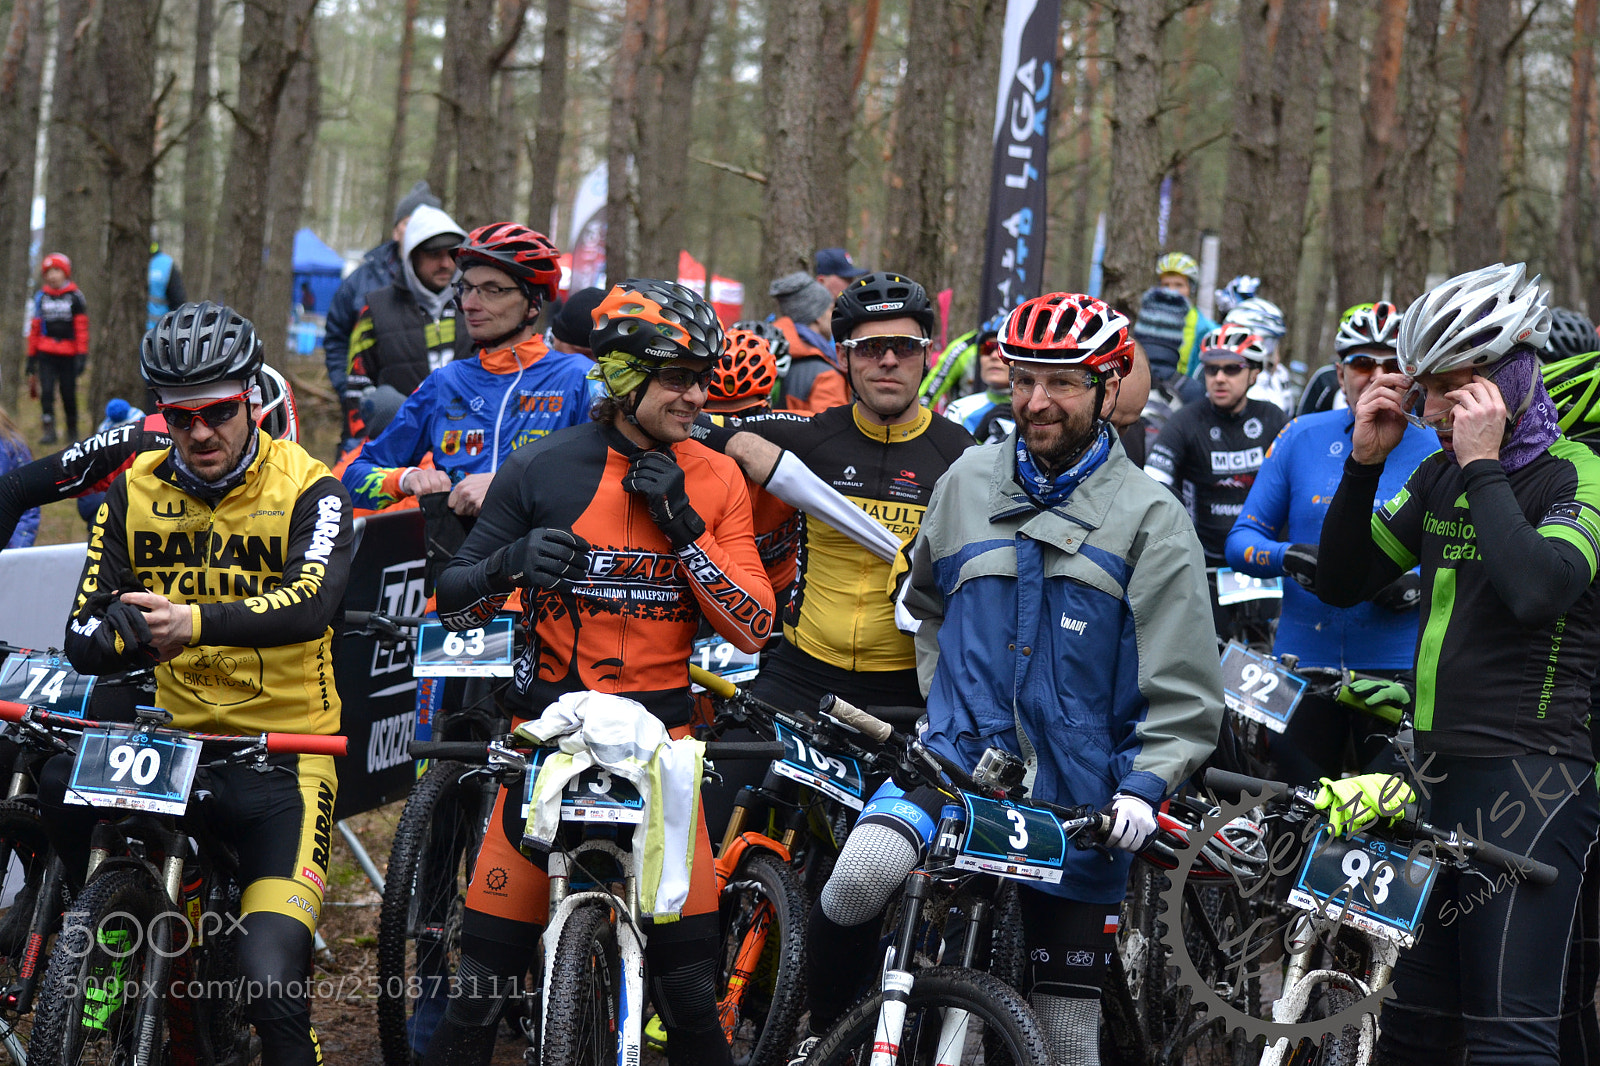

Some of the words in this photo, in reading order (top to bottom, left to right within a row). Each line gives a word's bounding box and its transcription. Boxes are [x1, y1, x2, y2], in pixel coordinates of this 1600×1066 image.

[1004, 57, 1037, 189] LIGA
[644, 348, 679, 358] catlike
[519, 396, 564, 412] MTB
[745, 413, 811, 423] RENAULT
[61, 424, 136, 467] PATNET
[1214, 450, 1260, 468] MCP
[833, 480, 864, 488] RENAULT
[305, 495, 342, 565] BARAN
[134, 531, 283, 573] BARAN
[137, 570, 283, 598] CYCLING
[244, 562, 325, 614] CYCLING
[571, 585, 627, 599] USZCZELNIAMY
[630, 590, 679, 602] NAJLEPSZYCH
[679, 543, 772, 639] TREZADO
[442, 627, 485, 656] 63
[698, 642, 735, 671] 19
[19, 667, 68, 704] 74
[183, 671, 213, 687] BIKE
[1238, 663, 1279, 703] 92
[1536, 665, 1556, 719] ambition
[109, 744, 161, 785] 90
[791, 735, 847, 779] 109
[312, 780, 335, 876] BARAN
[1006, 809, 1029, 850] 3
[1341, 849, 1396, 905] 93
